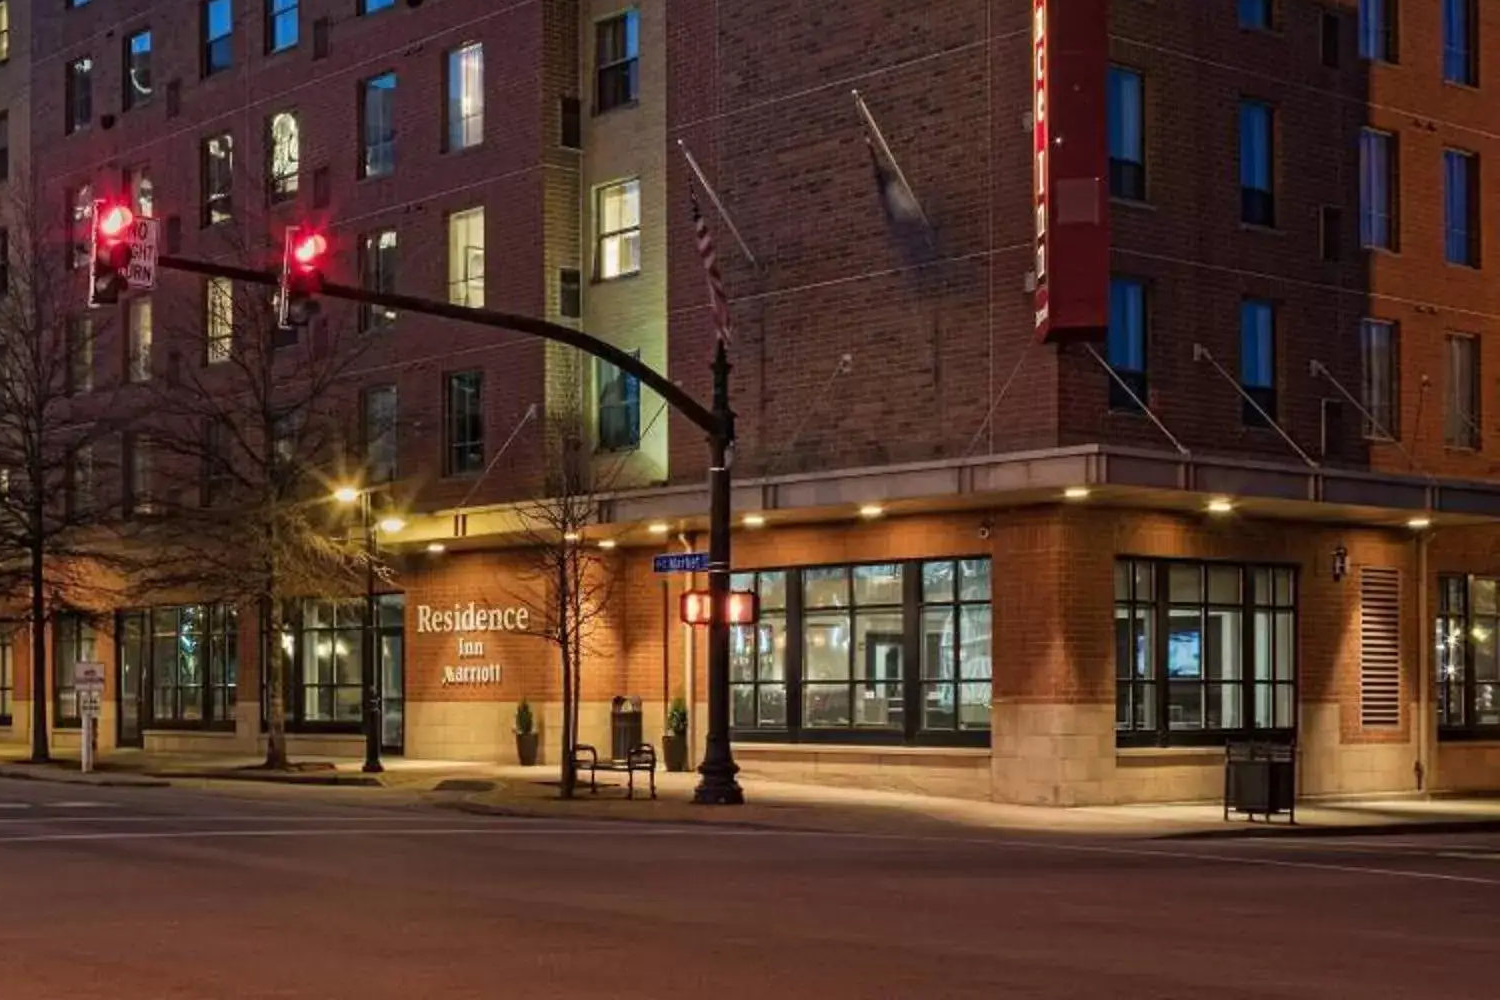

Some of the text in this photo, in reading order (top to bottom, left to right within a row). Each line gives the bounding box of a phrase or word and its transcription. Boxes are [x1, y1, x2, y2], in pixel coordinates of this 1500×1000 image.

[417, 601, 529, 633] Residence
[458, 637, 485, 657] Inn
[441, 664, 501, 685] Marriott
